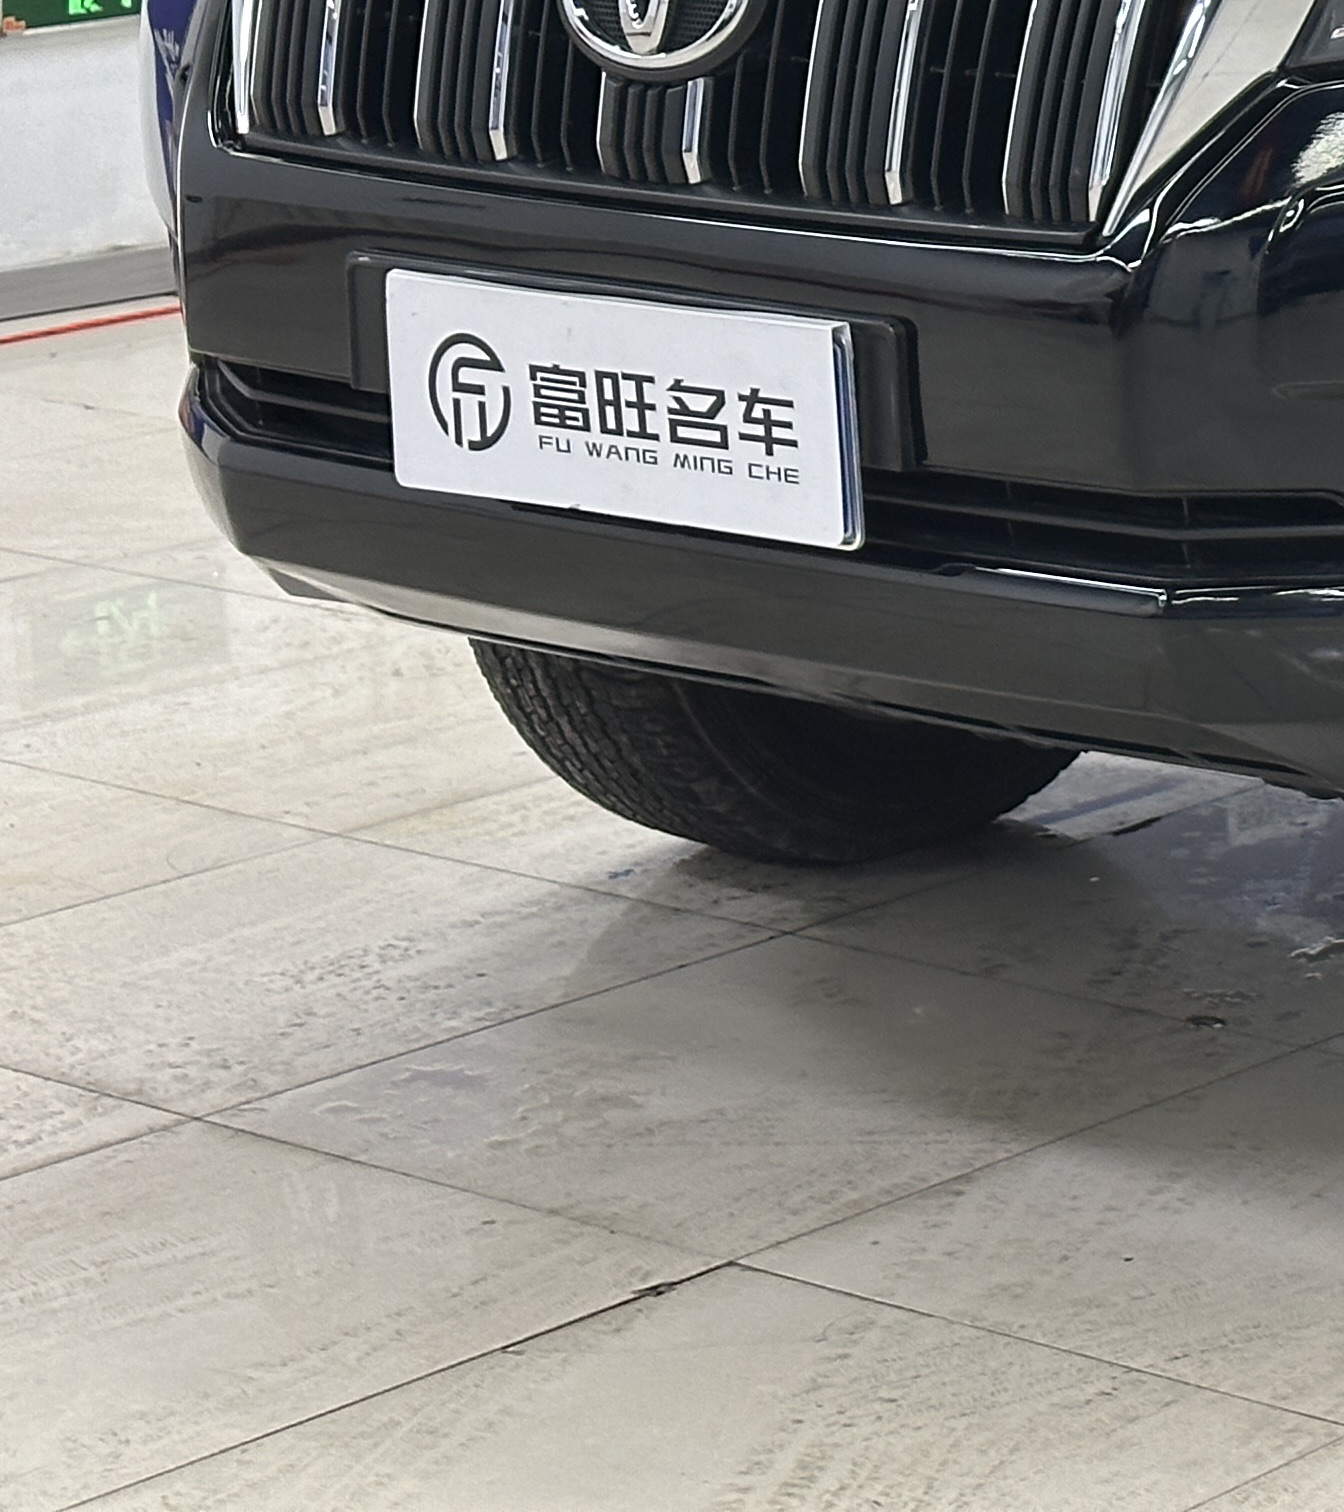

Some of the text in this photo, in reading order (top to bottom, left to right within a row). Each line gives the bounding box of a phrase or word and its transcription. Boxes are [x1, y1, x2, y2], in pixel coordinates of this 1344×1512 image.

[528, 363, 799, 456] 富旺名车
[538, 434, 800, 485] FU WANG MING CHE
